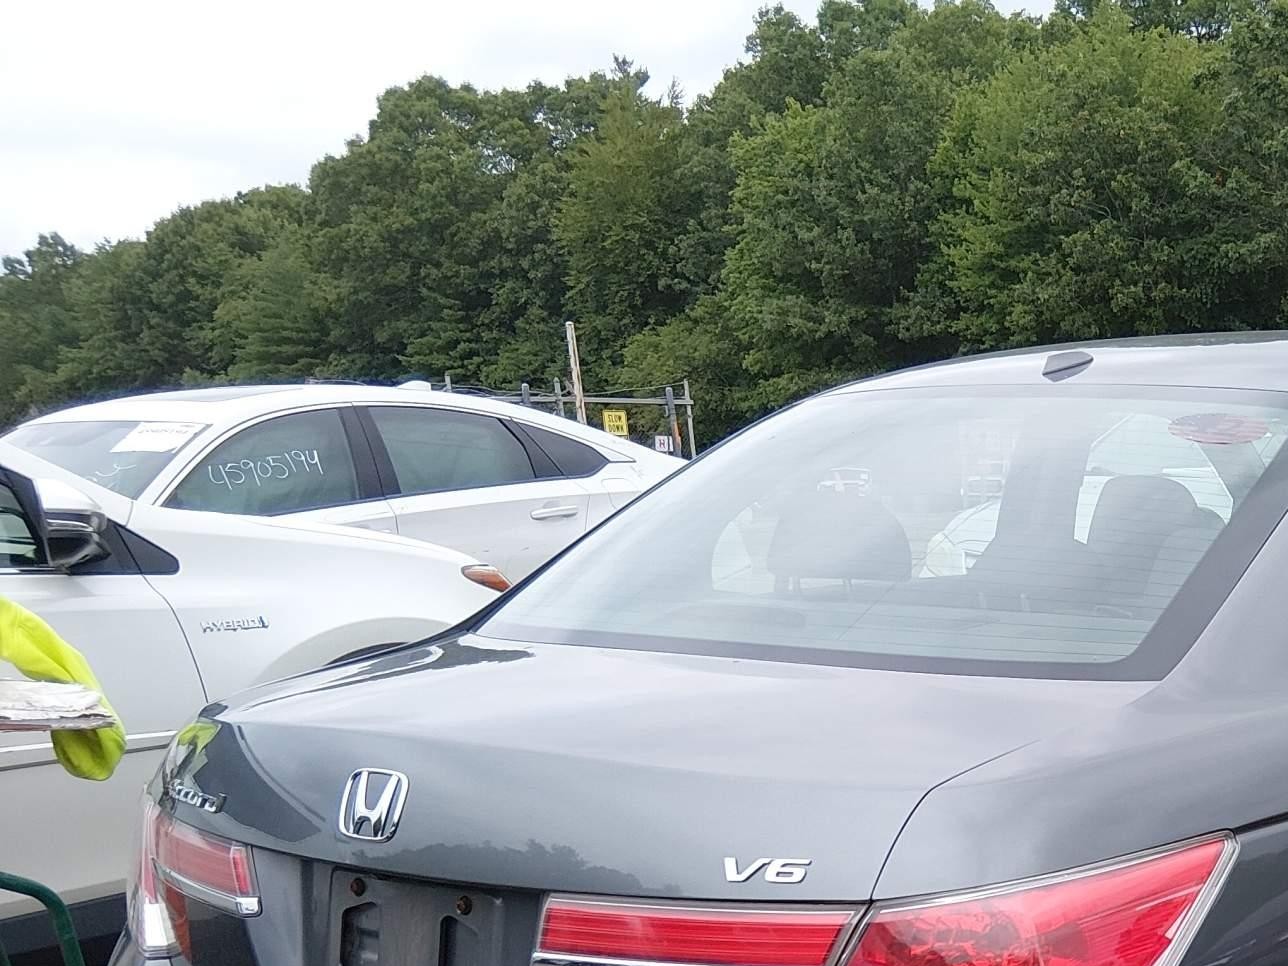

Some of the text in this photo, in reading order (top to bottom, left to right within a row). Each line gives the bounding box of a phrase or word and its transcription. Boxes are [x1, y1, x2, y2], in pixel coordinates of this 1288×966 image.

[607, 414, 623, 423] SLOW
[608, 424, 625, 432] DOWN
[208, 449, 324, 490] 45905194
[724, 857, 812, 884] V6
